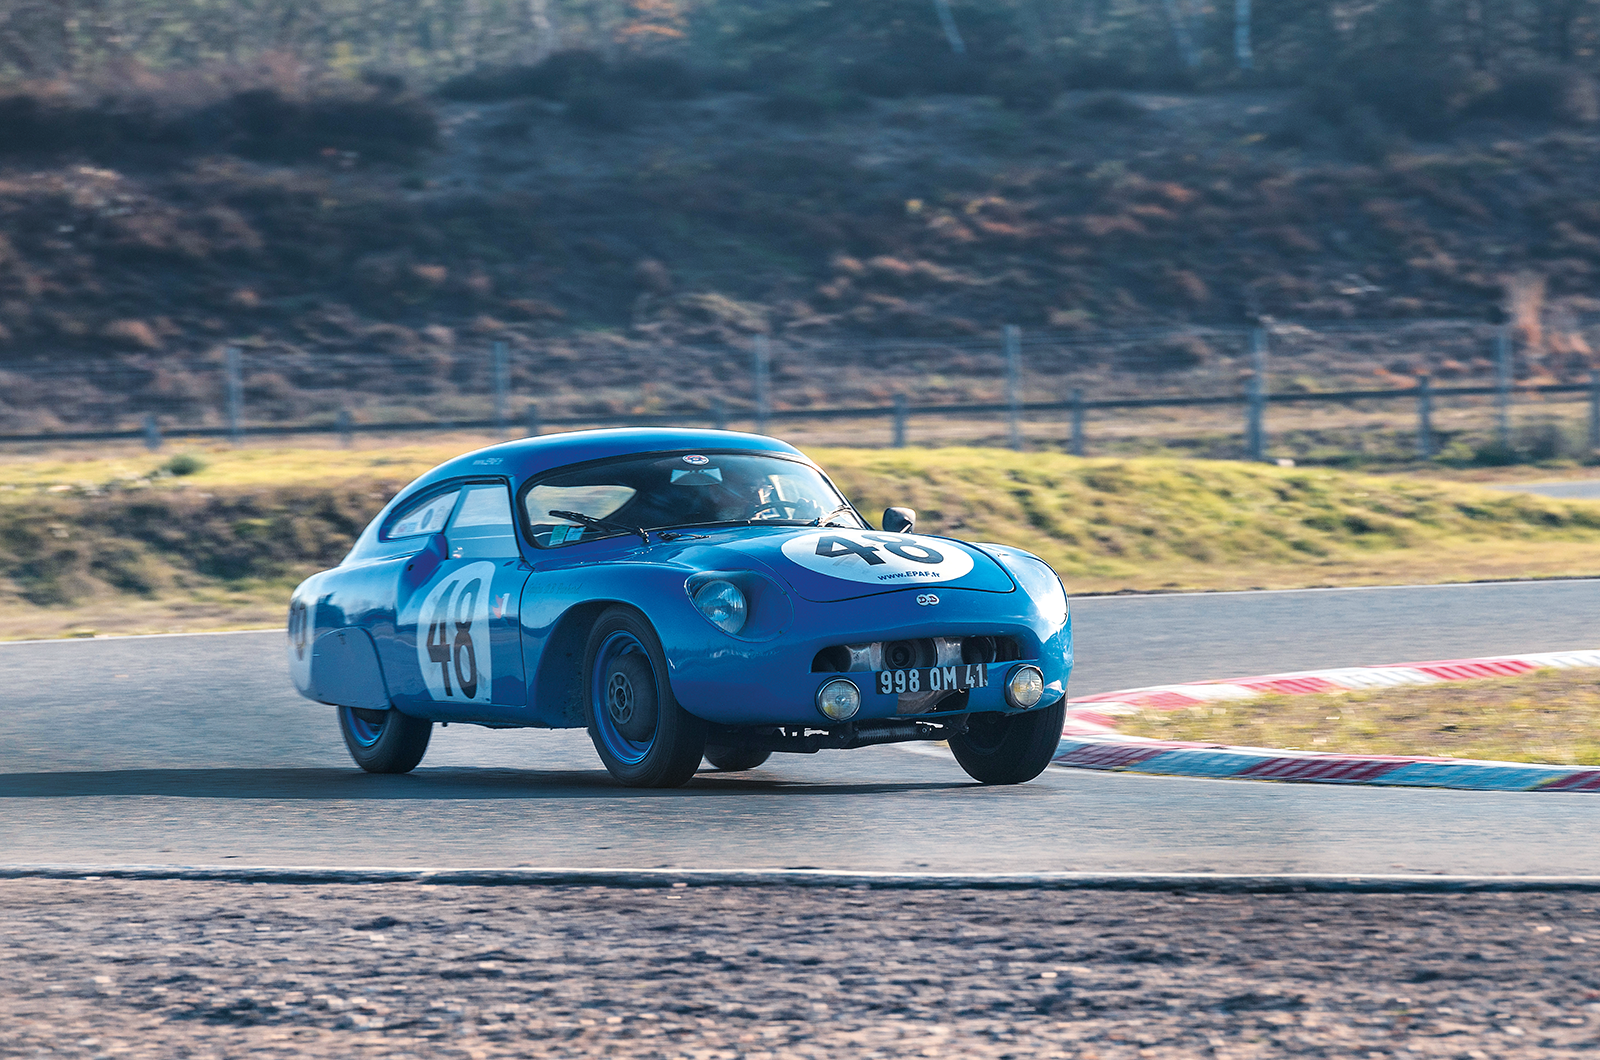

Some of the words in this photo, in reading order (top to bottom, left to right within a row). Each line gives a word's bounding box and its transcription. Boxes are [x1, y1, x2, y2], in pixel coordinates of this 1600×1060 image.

[815, 534, 944, 566] 48
[426, 577, 482, 699] 48
[880, 669, 920, 695] 998
[930, 665, 958, 691] QM
[965, 663, 984, 688] 41
